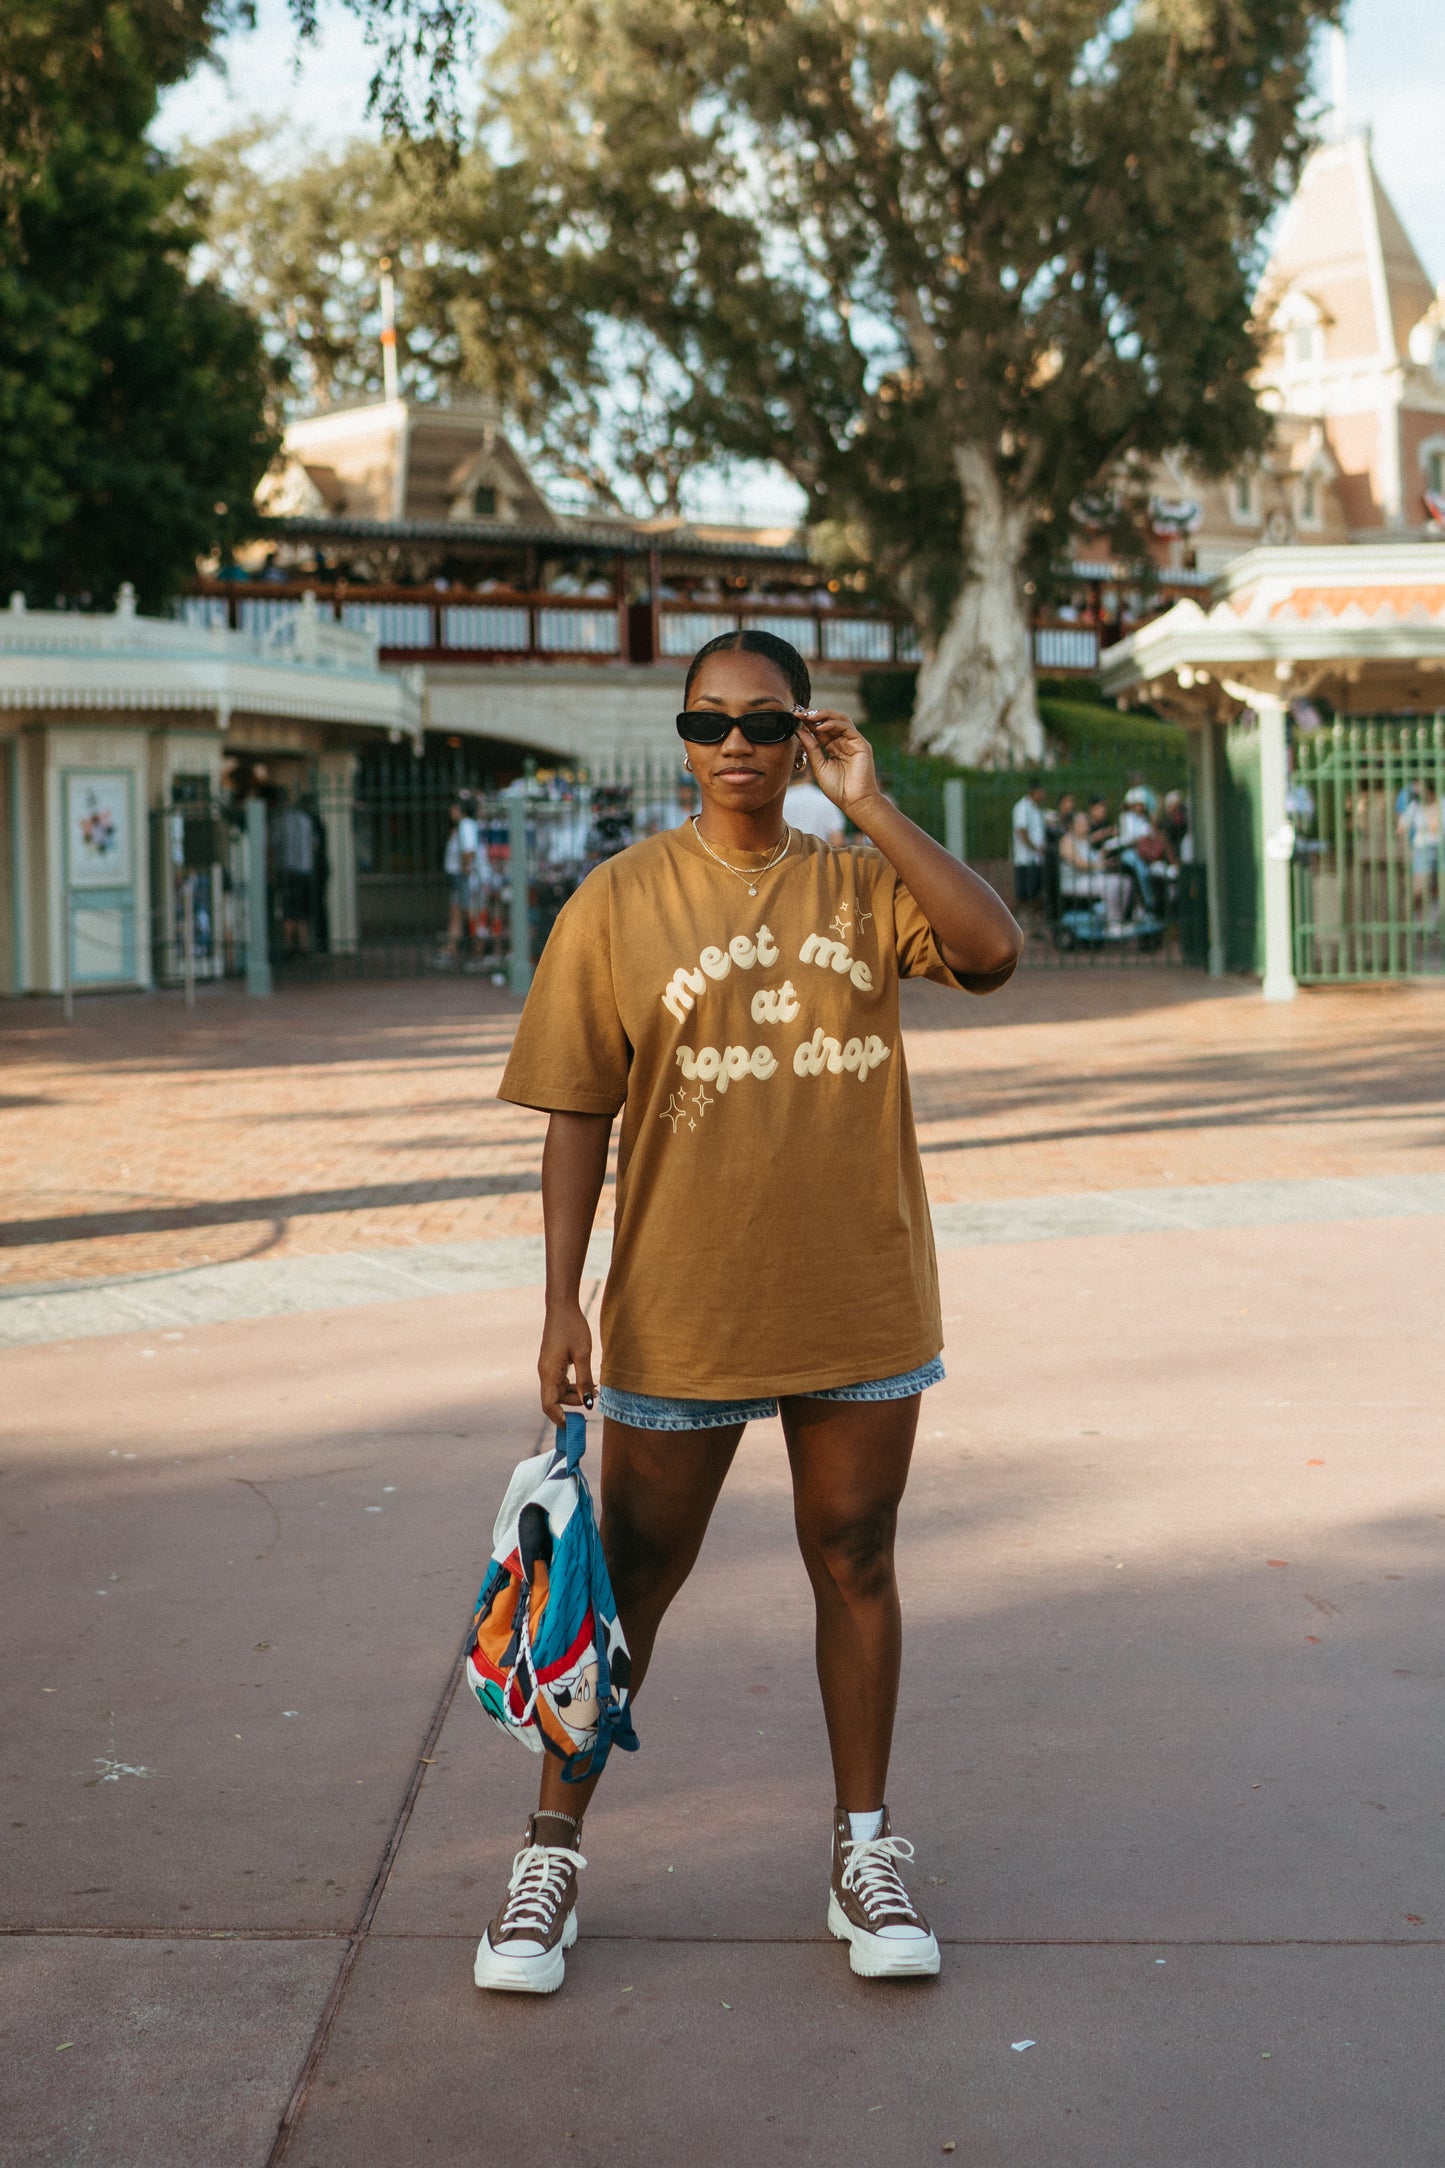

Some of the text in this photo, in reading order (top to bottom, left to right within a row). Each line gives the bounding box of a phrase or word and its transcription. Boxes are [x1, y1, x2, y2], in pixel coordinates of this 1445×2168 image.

[661, 924, 874, 1024] meet me
[751, 980, 800, 1024] at
[676, 1027, 891, 1093] rope drop
